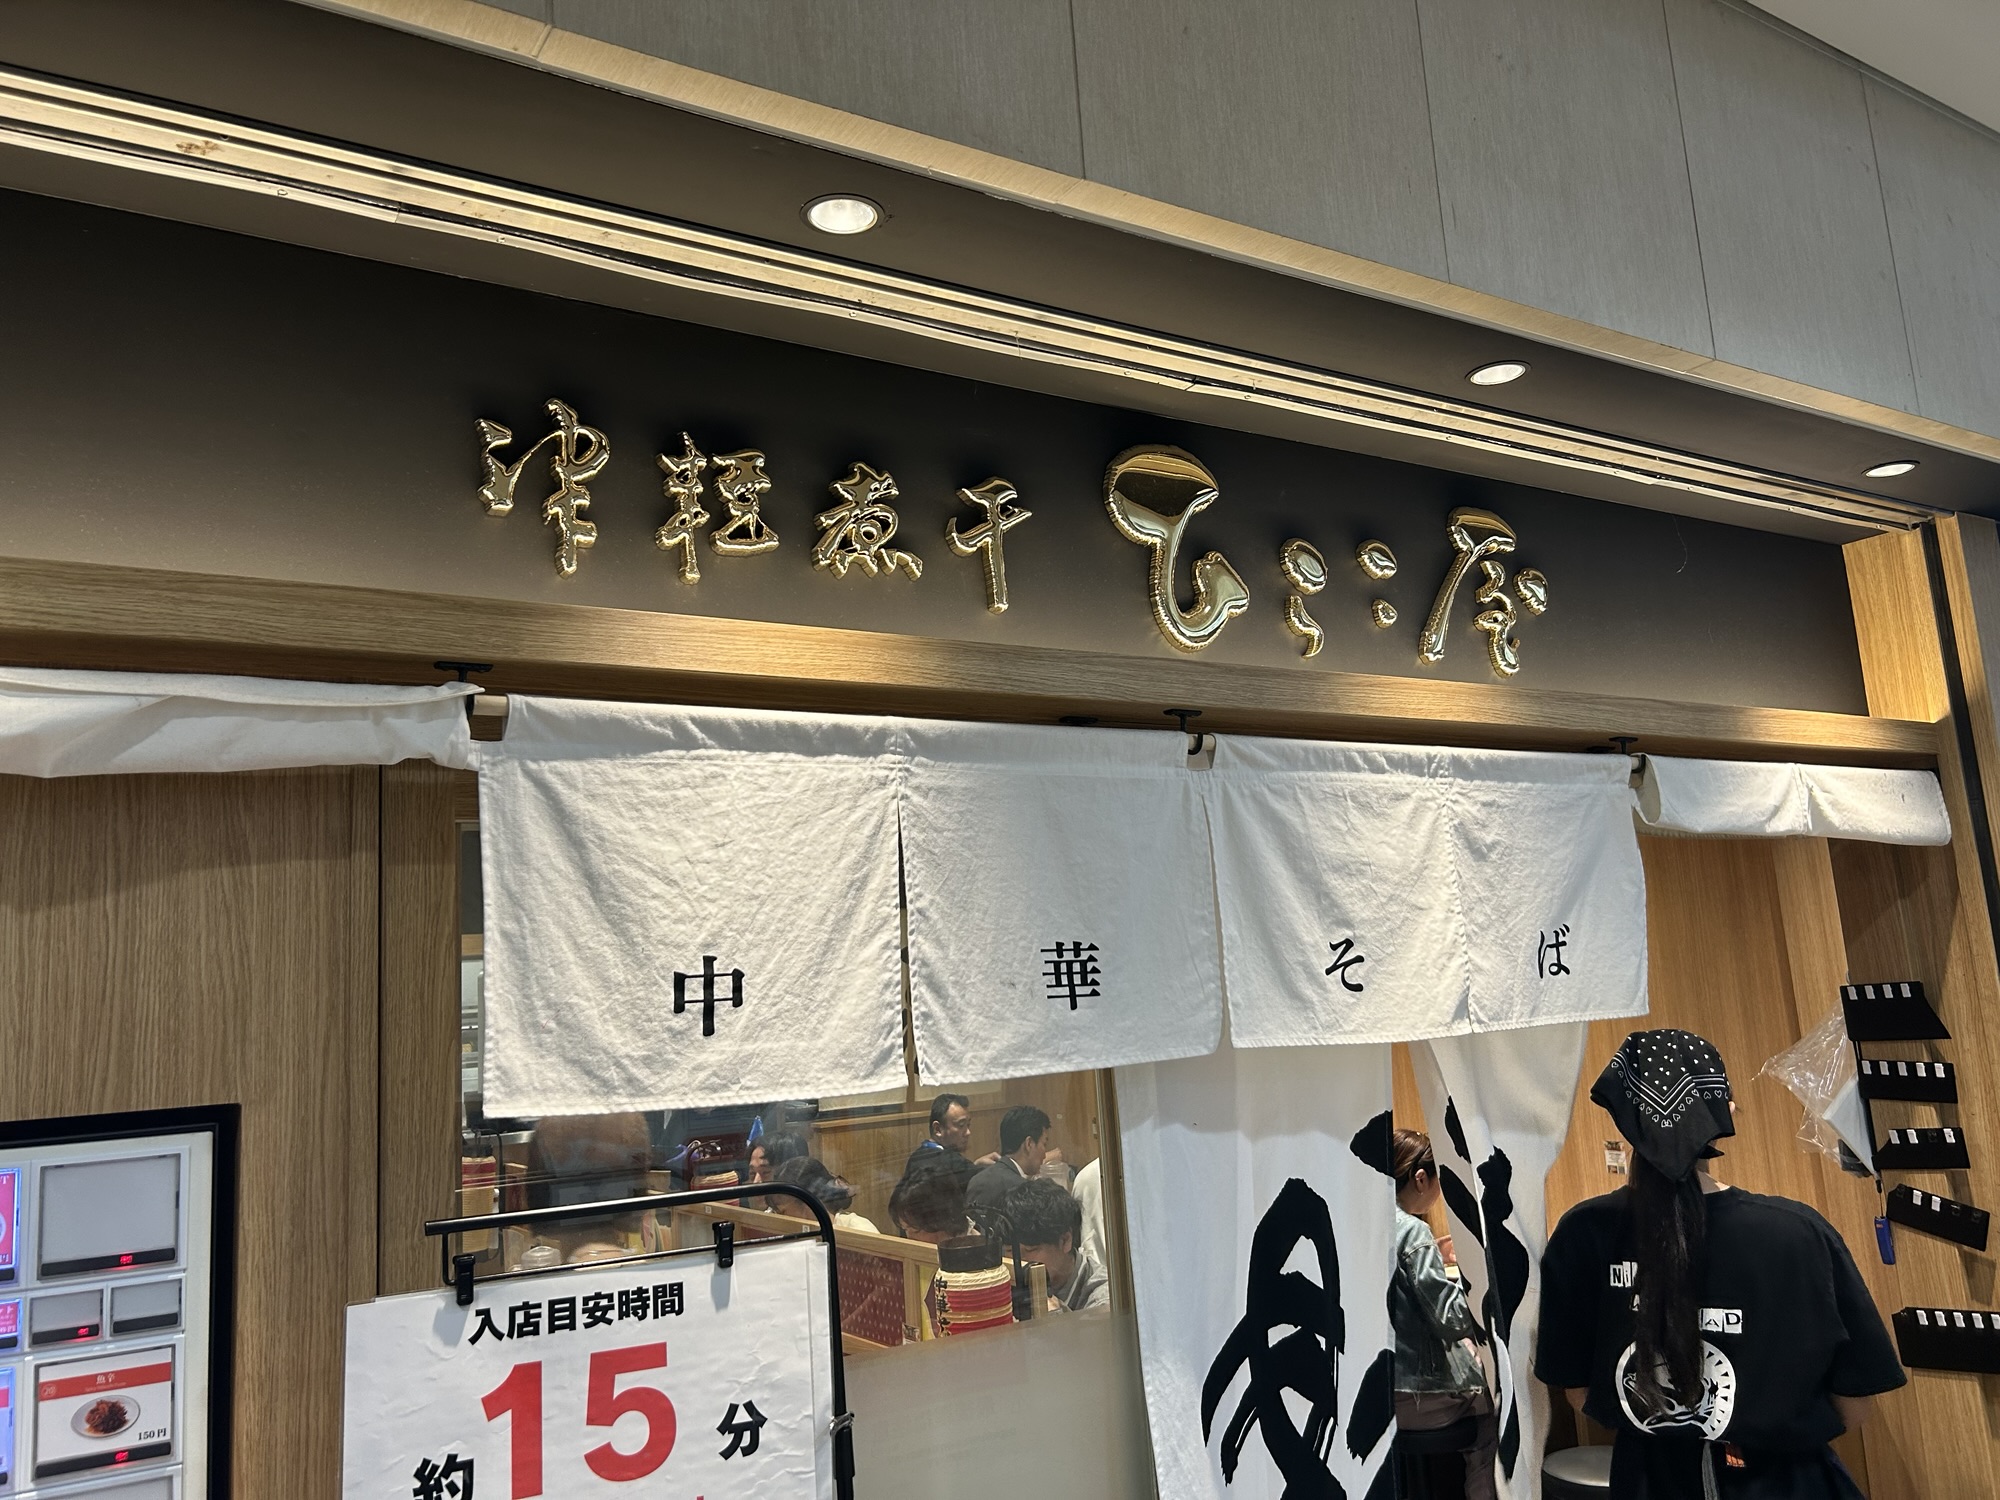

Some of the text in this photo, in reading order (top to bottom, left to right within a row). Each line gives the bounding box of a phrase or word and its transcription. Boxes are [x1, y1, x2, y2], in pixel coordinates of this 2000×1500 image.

[468, 1282, 684, 1346] 入店目安時間
